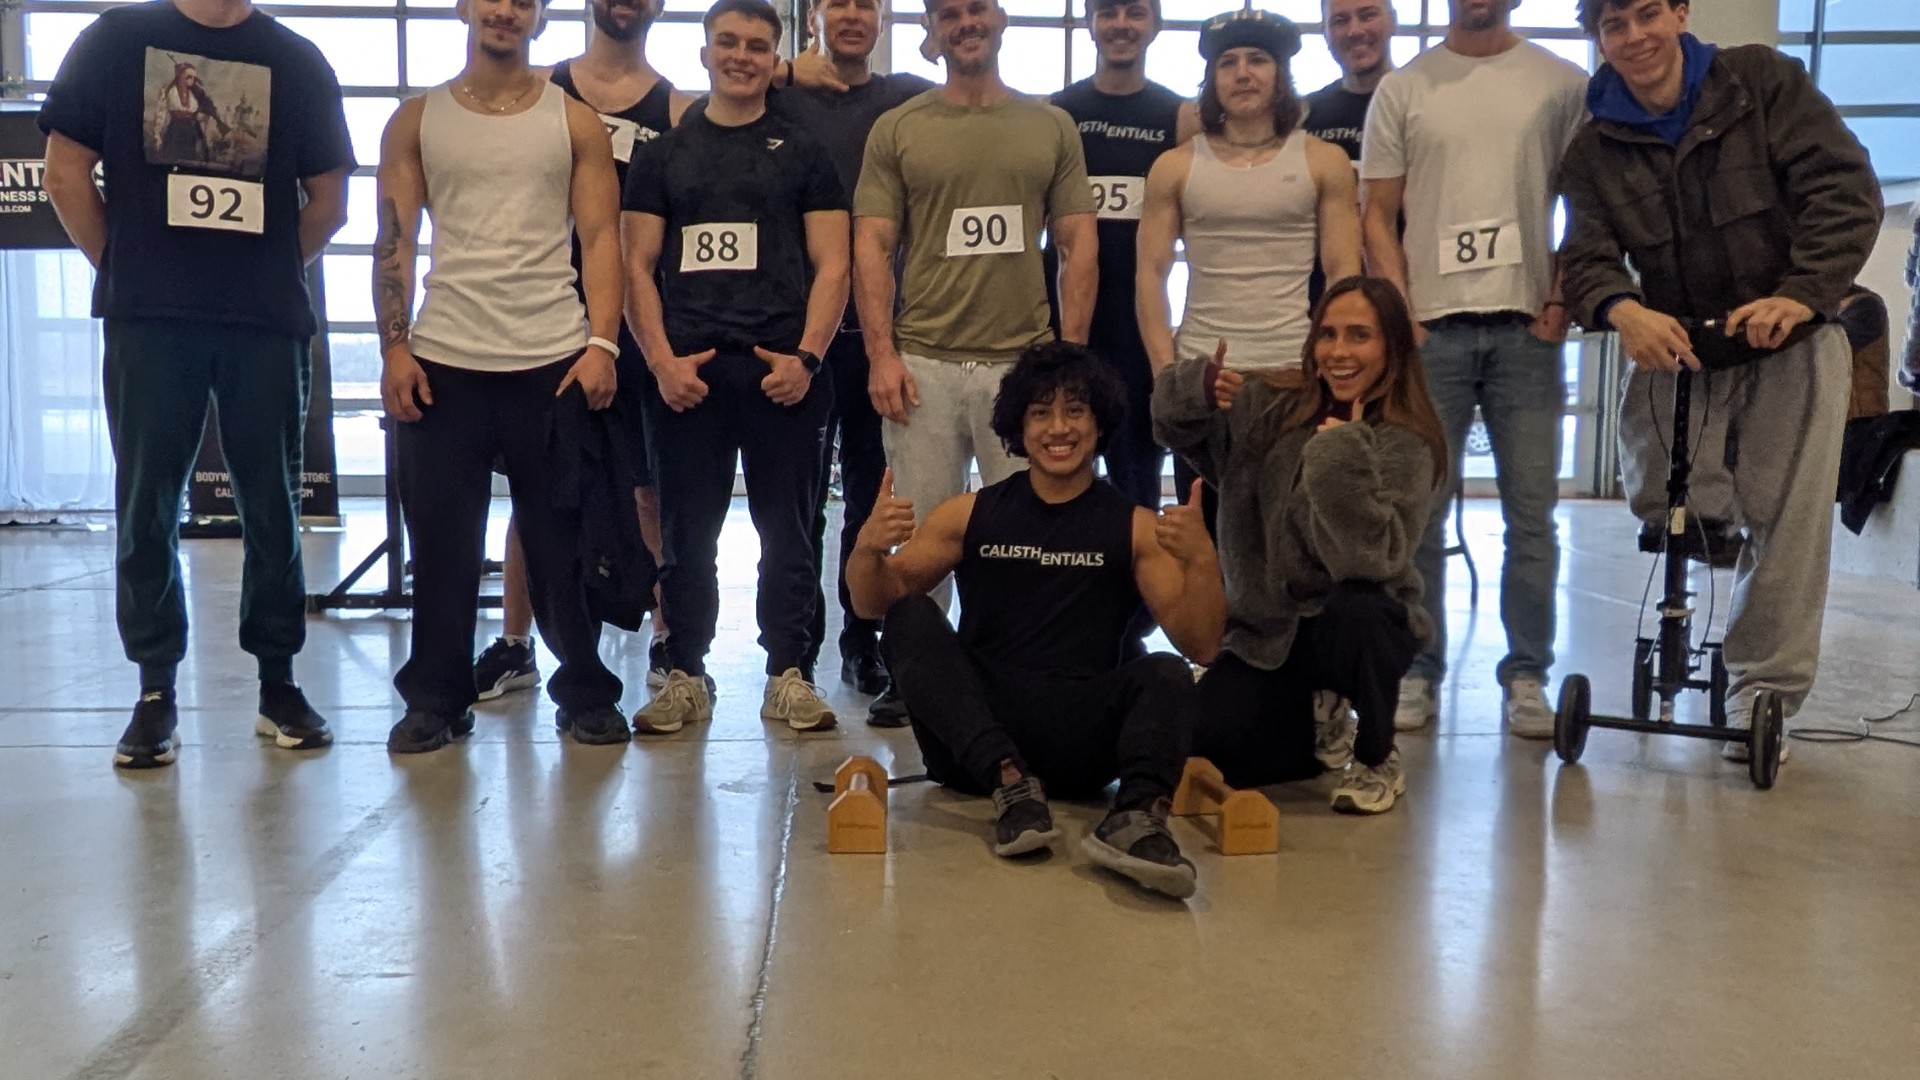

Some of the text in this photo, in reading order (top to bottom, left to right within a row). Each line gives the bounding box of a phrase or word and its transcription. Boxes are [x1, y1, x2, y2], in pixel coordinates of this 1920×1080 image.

[1078, 120, 1166, 142] ISTHENTIALS
[0, 190, 48, 202] NESS S
[189, 184, 244, 223] 92
[1091, 182, 1129, 212] 95
[962, 213, 1008, 248] 90
[1456, 226, 1501, 264] 87
[696, 230, 739, 263] 88
[195, 471, 230, 482] BODYW
[979, 544, 1105, 566] CALISTHENTIALS
